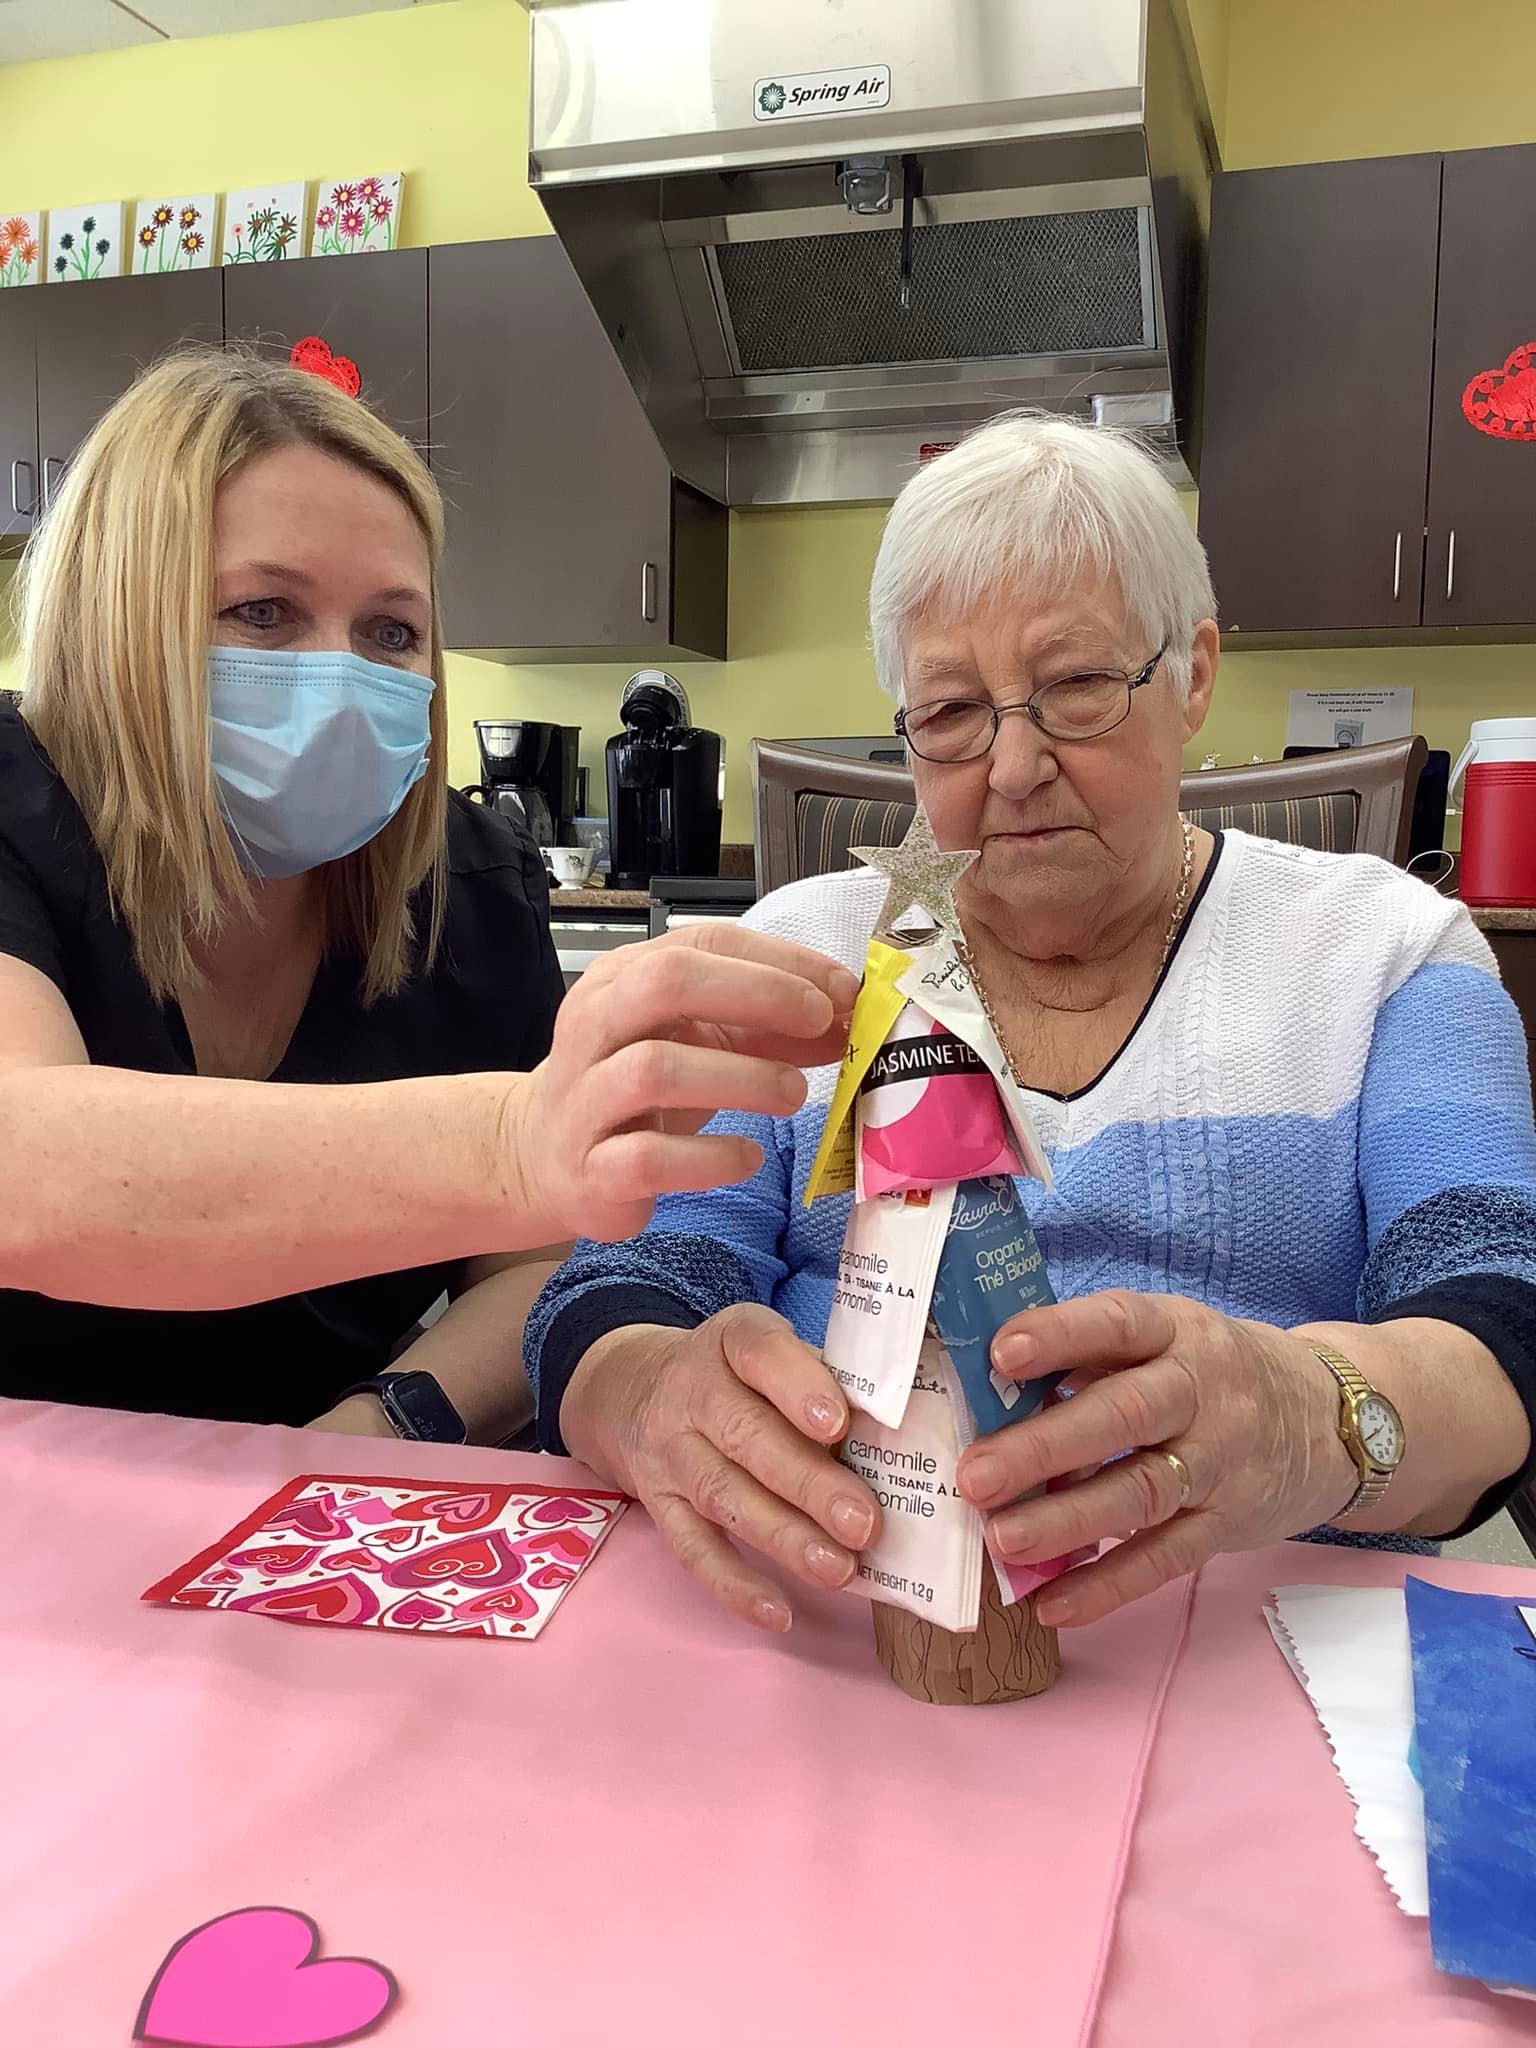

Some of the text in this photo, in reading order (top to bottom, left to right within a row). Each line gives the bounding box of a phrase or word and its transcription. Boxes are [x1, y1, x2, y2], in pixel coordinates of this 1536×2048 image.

[788, 77, 884, 106] Spring Air
[871, 1044, 954, 1079] JASMINE
[955, 1043, 980, 1064] TE
[975, 1235, 1026, 1269] Organic
[897, 1286, 915, 1299] LA
[973, 1268, 1004, 1293] Thé
[849, 1439, 937, 1474] camomile
[860, 1466, 962, 1498] TEA TISANE À L
[871, 1488, 936, 1518] omille
[857, 1563, 872, 1581] NET
[873, 1569, 909, 1593] WEIGHT
[925, 1587, 934, 1603] g
